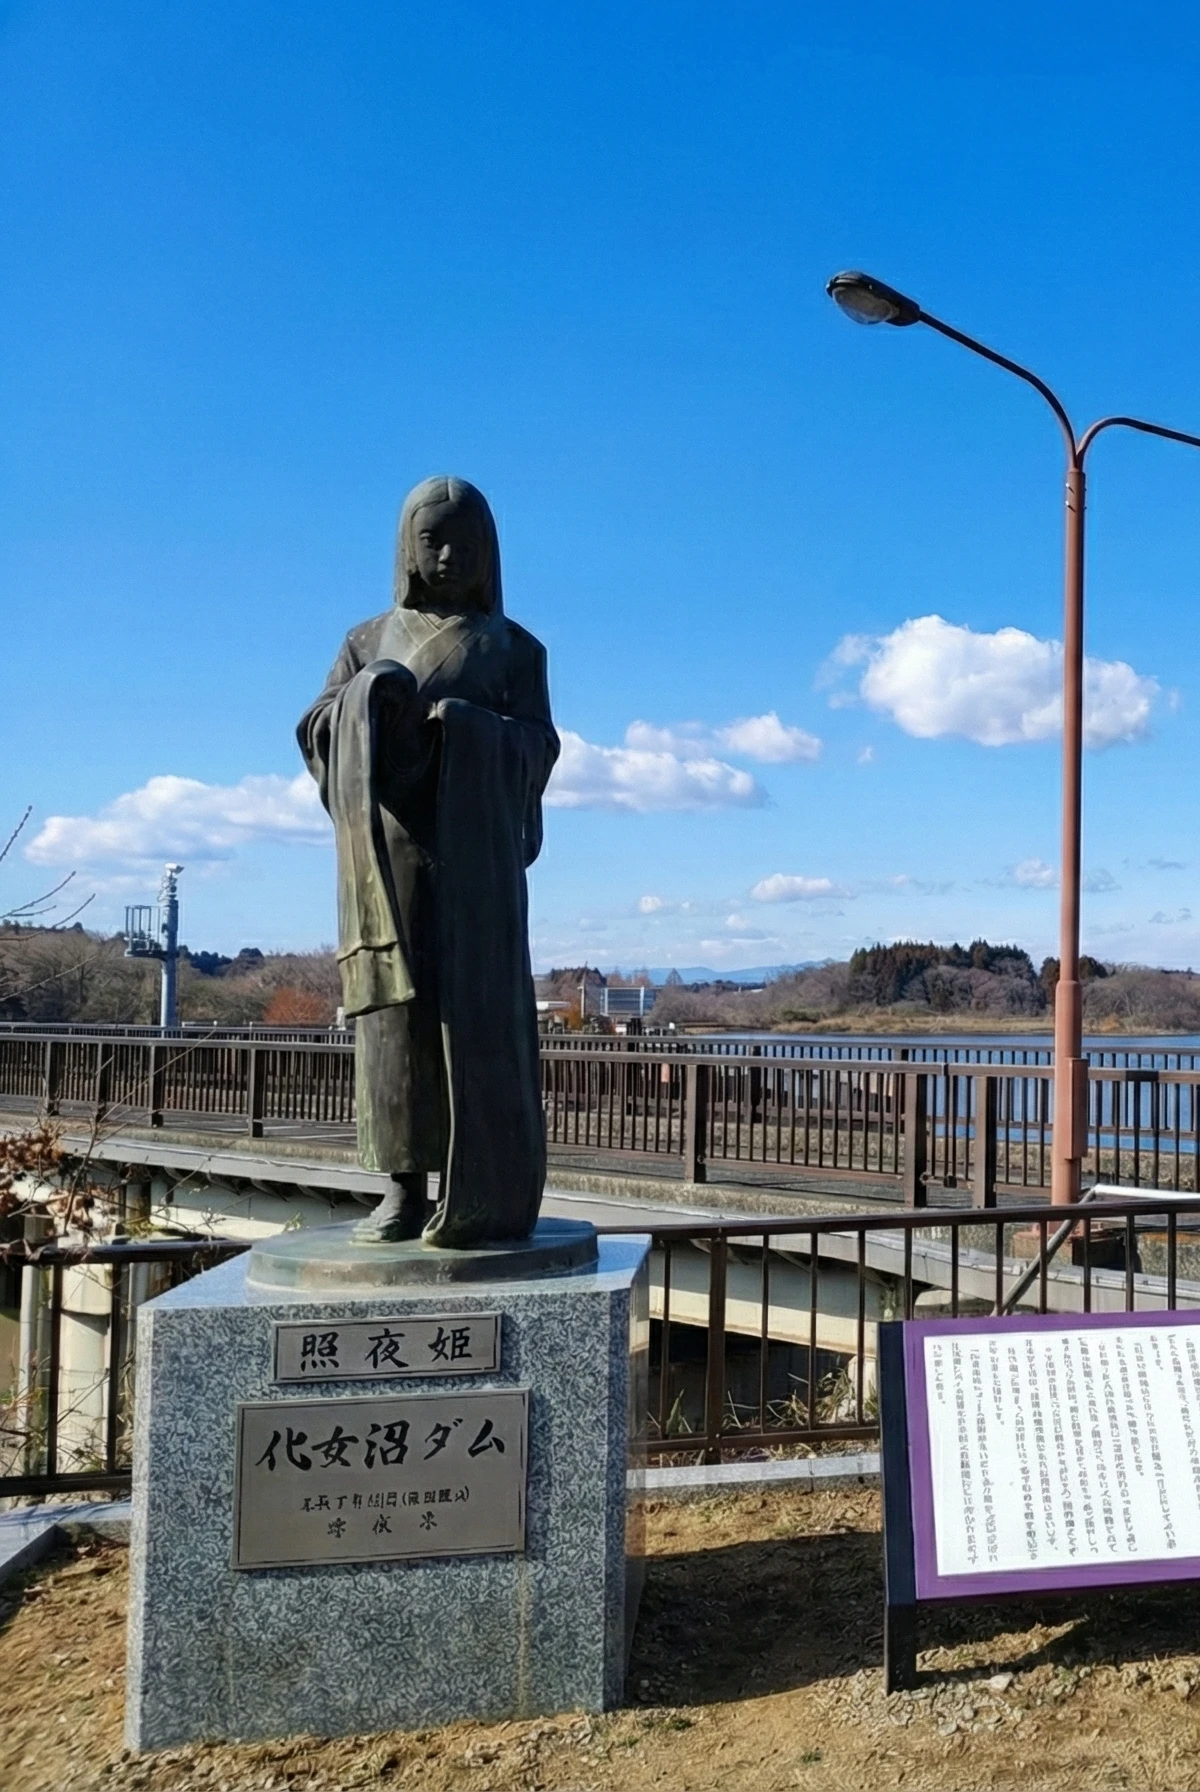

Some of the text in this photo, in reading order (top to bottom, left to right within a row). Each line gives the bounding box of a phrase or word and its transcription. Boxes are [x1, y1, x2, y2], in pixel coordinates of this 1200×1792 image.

[300, 1326, 473, 1372] 照夜姫
[255, 1418, 505, 1471] 化女沼ダム
